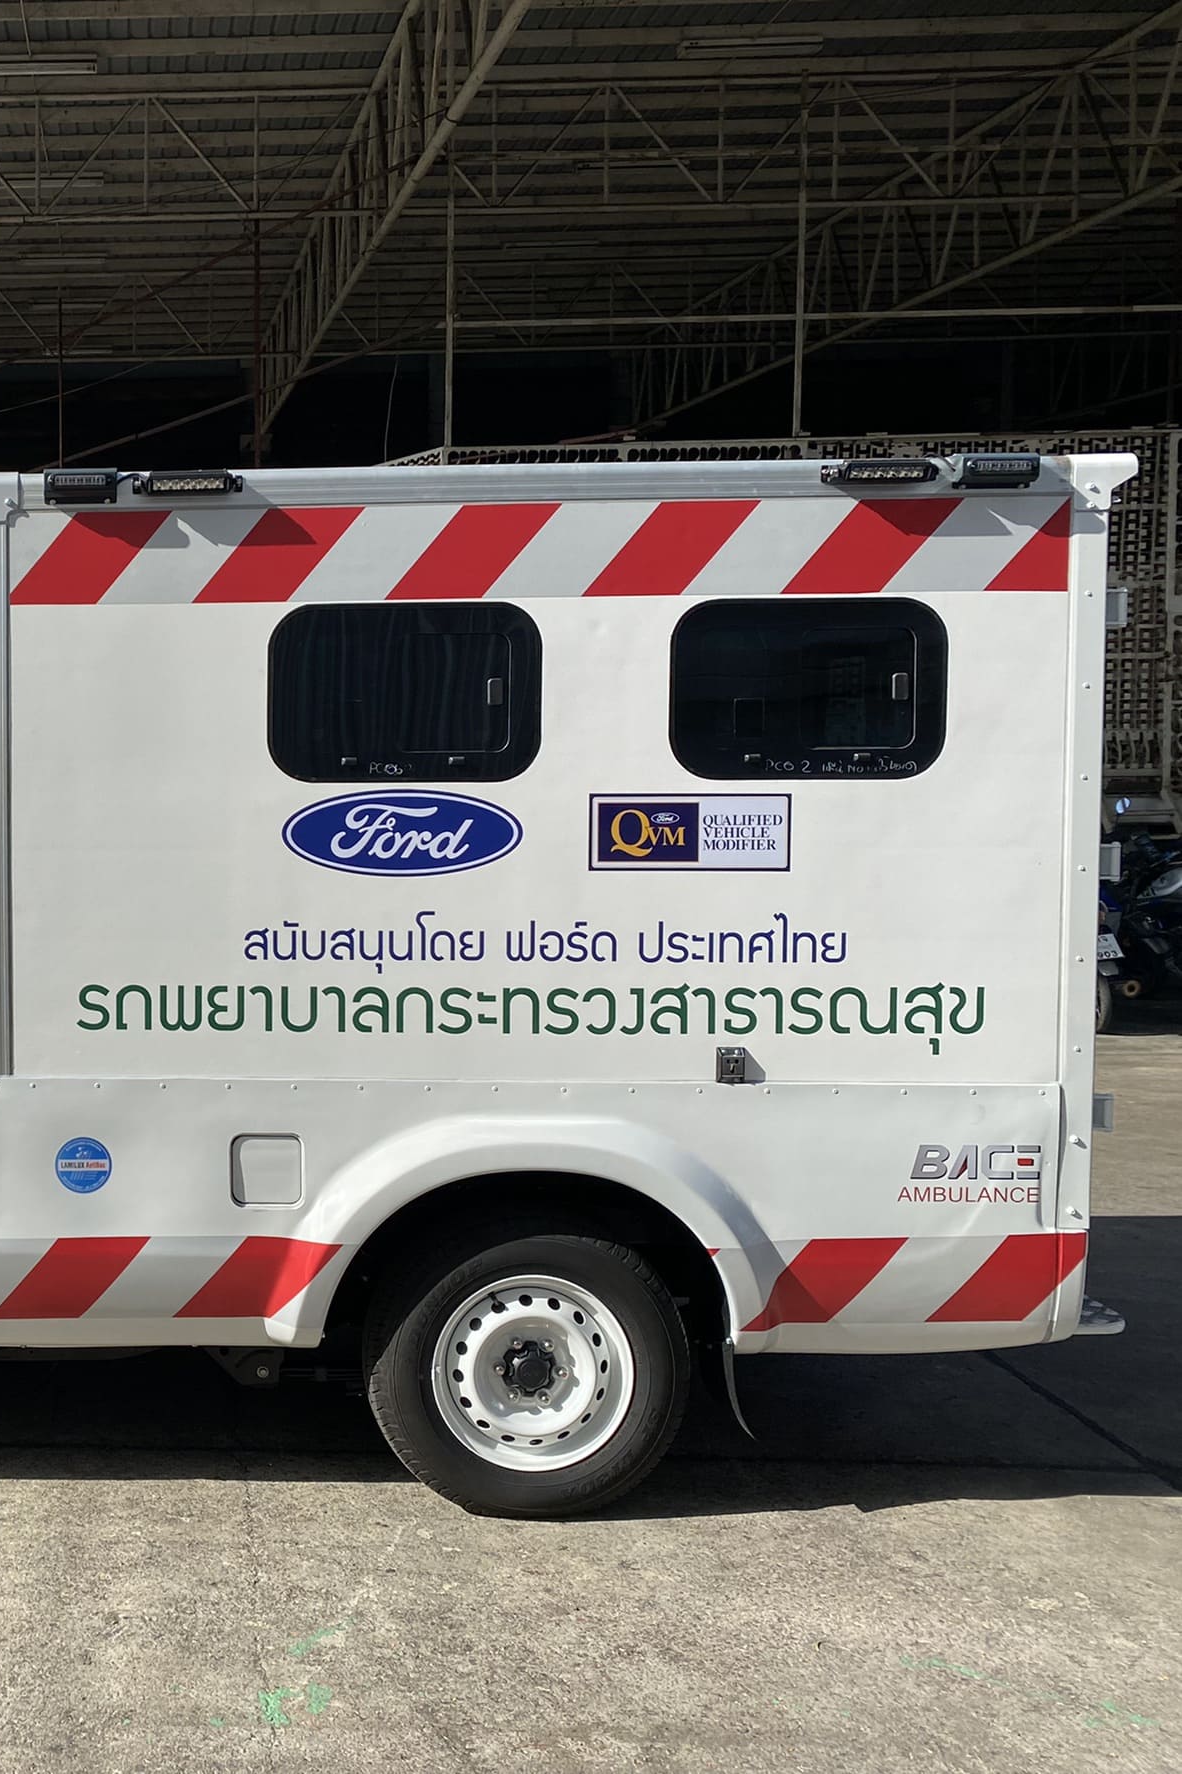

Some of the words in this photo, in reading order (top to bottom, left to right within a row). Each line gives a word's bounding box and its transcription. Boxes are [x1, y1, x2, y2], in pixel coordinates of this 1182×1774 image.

[330, 803, 474, 860] Ford
[702, 813, 784, 828] QUALIFIED
[702, 826, 771, 839] VEHICLE
[702, 838, 777, 851] MODIFIER
[243, 910, 486, 975] สนับสนุนโดย
[505, 919, 618, 963] ฟอร์ด
[638, 911, 848, 964] ประเทศไทย
[76, 982, 986, 1056] รถพยาบาลกระทรวงสาธารณสุข
[909, 1144, 1042, 1180] BACE
[897, 1186, 1040, 1204] AMBULANCE
